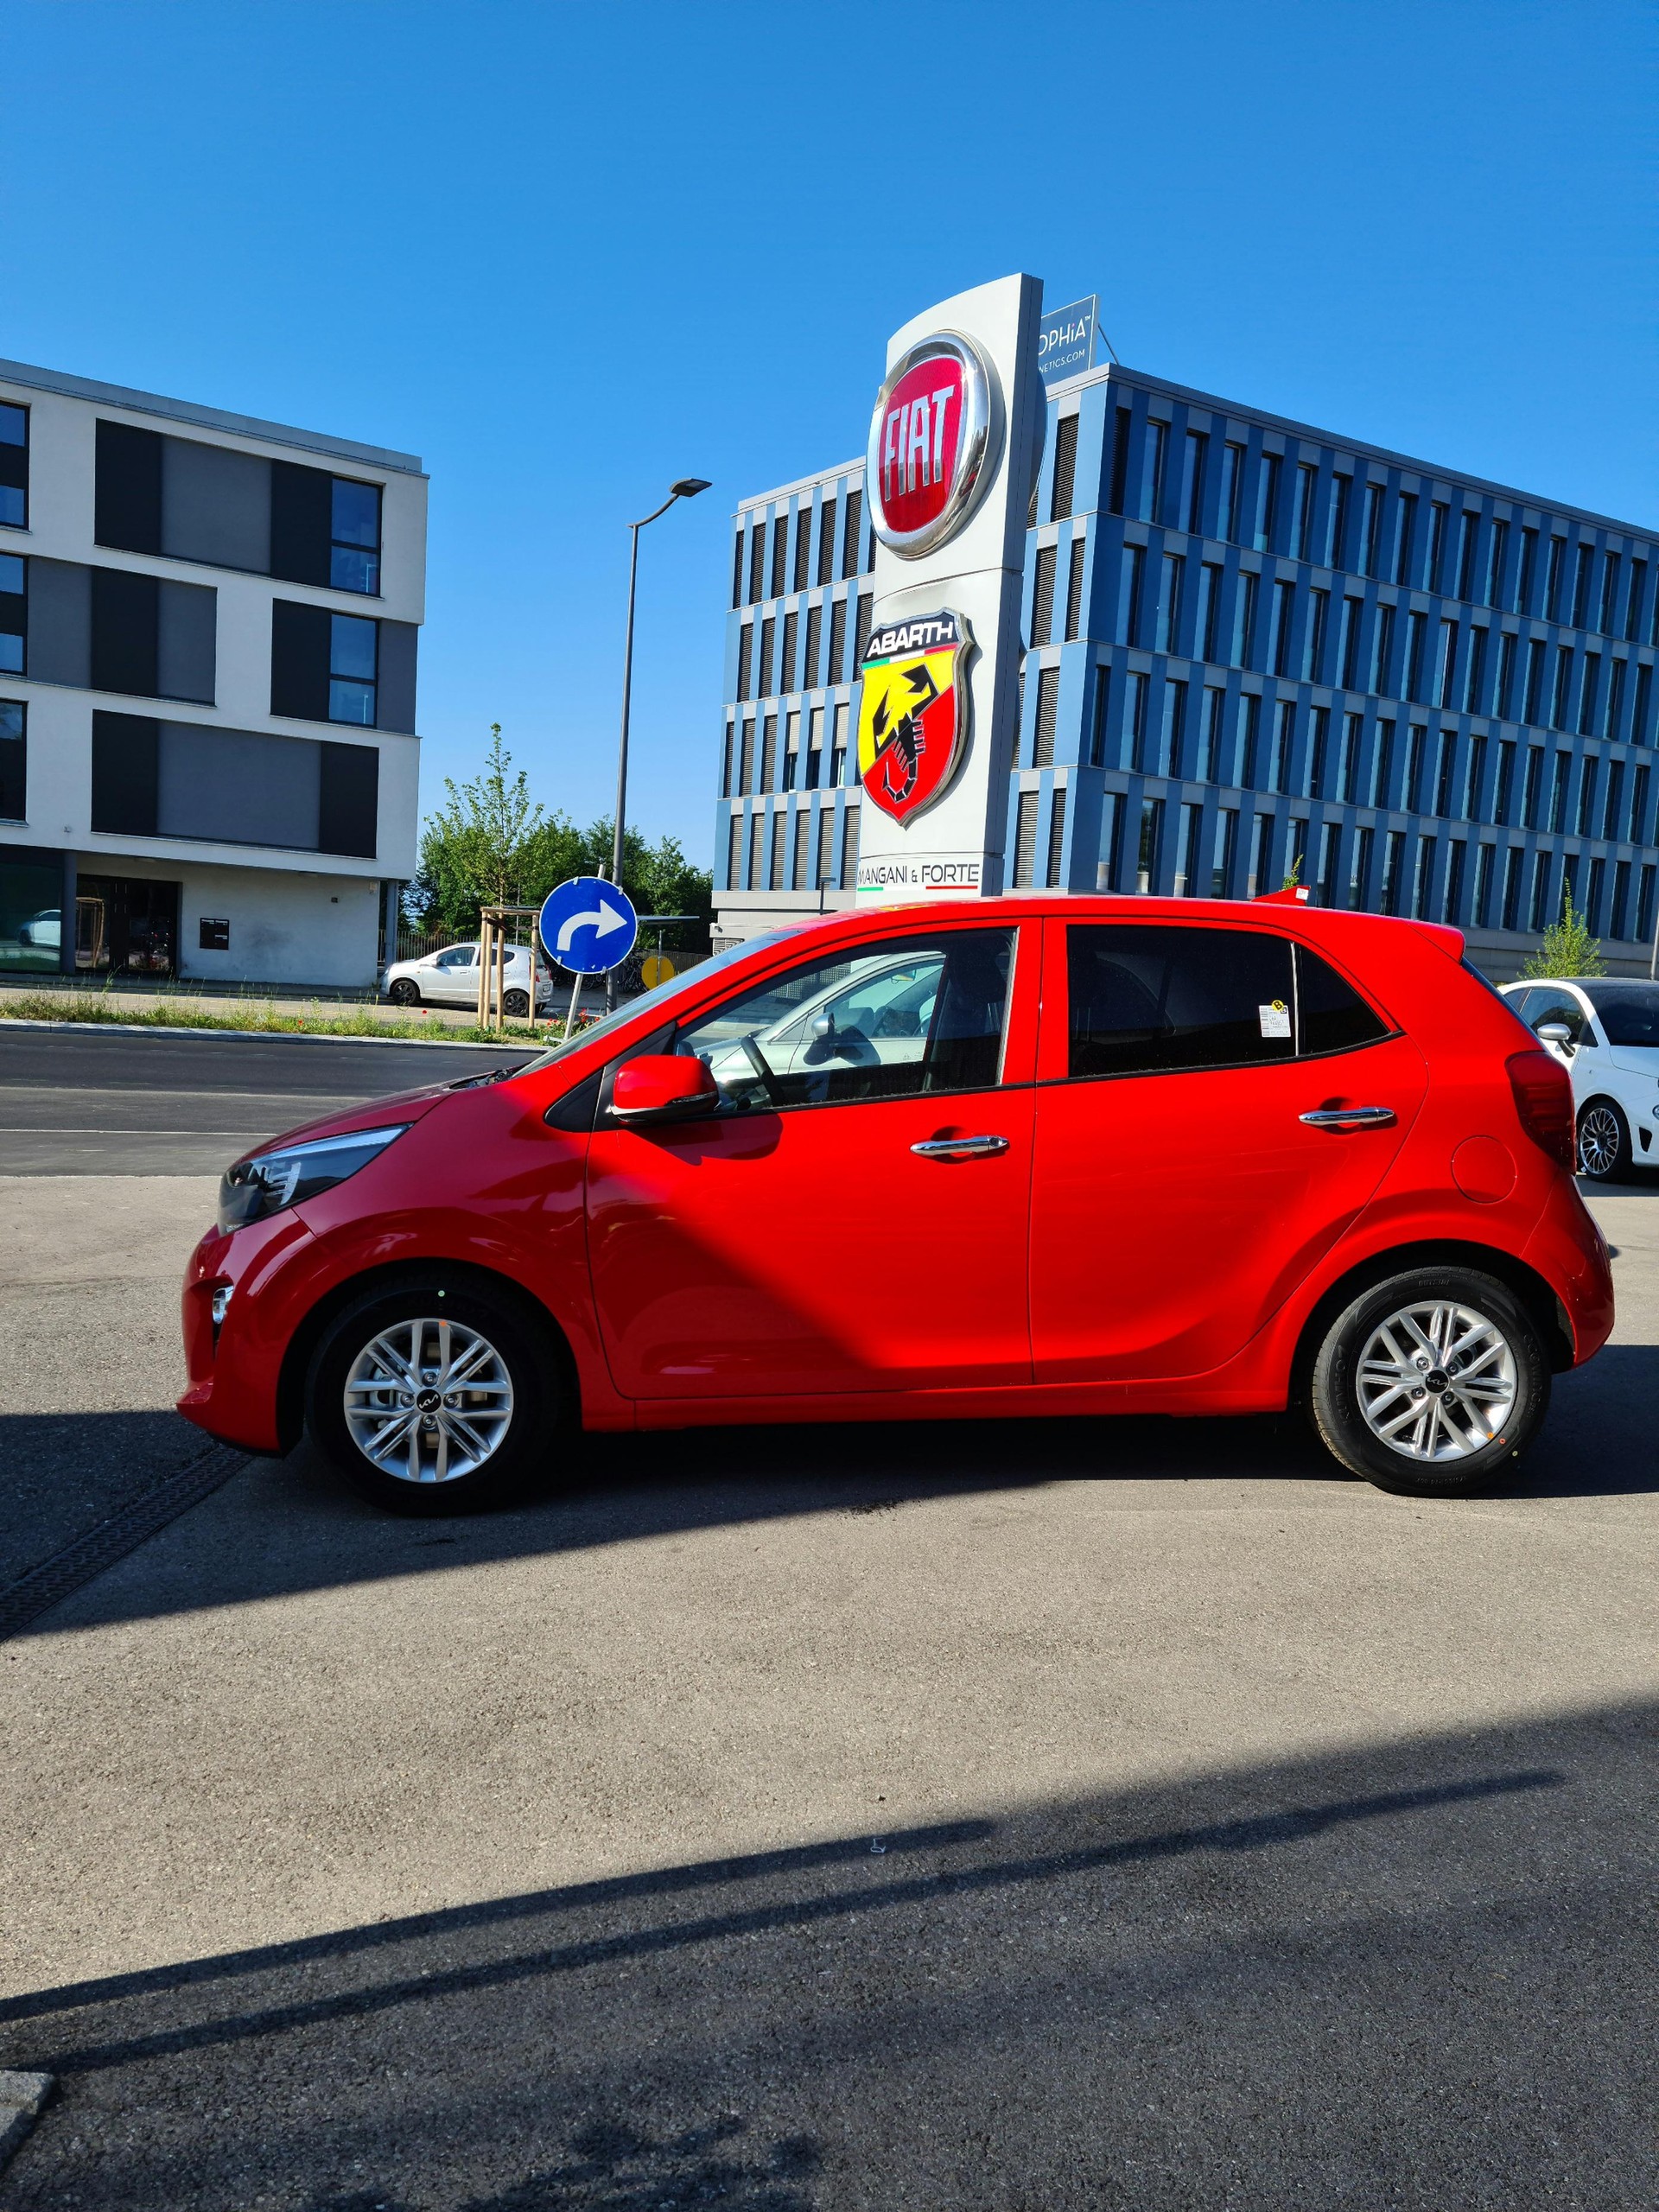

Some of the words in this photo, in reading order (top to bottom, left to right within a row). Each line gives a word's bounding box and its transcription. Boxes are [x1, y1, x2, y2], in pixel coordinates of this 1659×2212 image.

[884, 385, 956, 502] FIAT
[867, 621, 953, 658] ABARTH
[858, 866, 907, 885] MANGANI
[912, 869, 918, 882] &
[921, 864, 980, 882] FORTE
